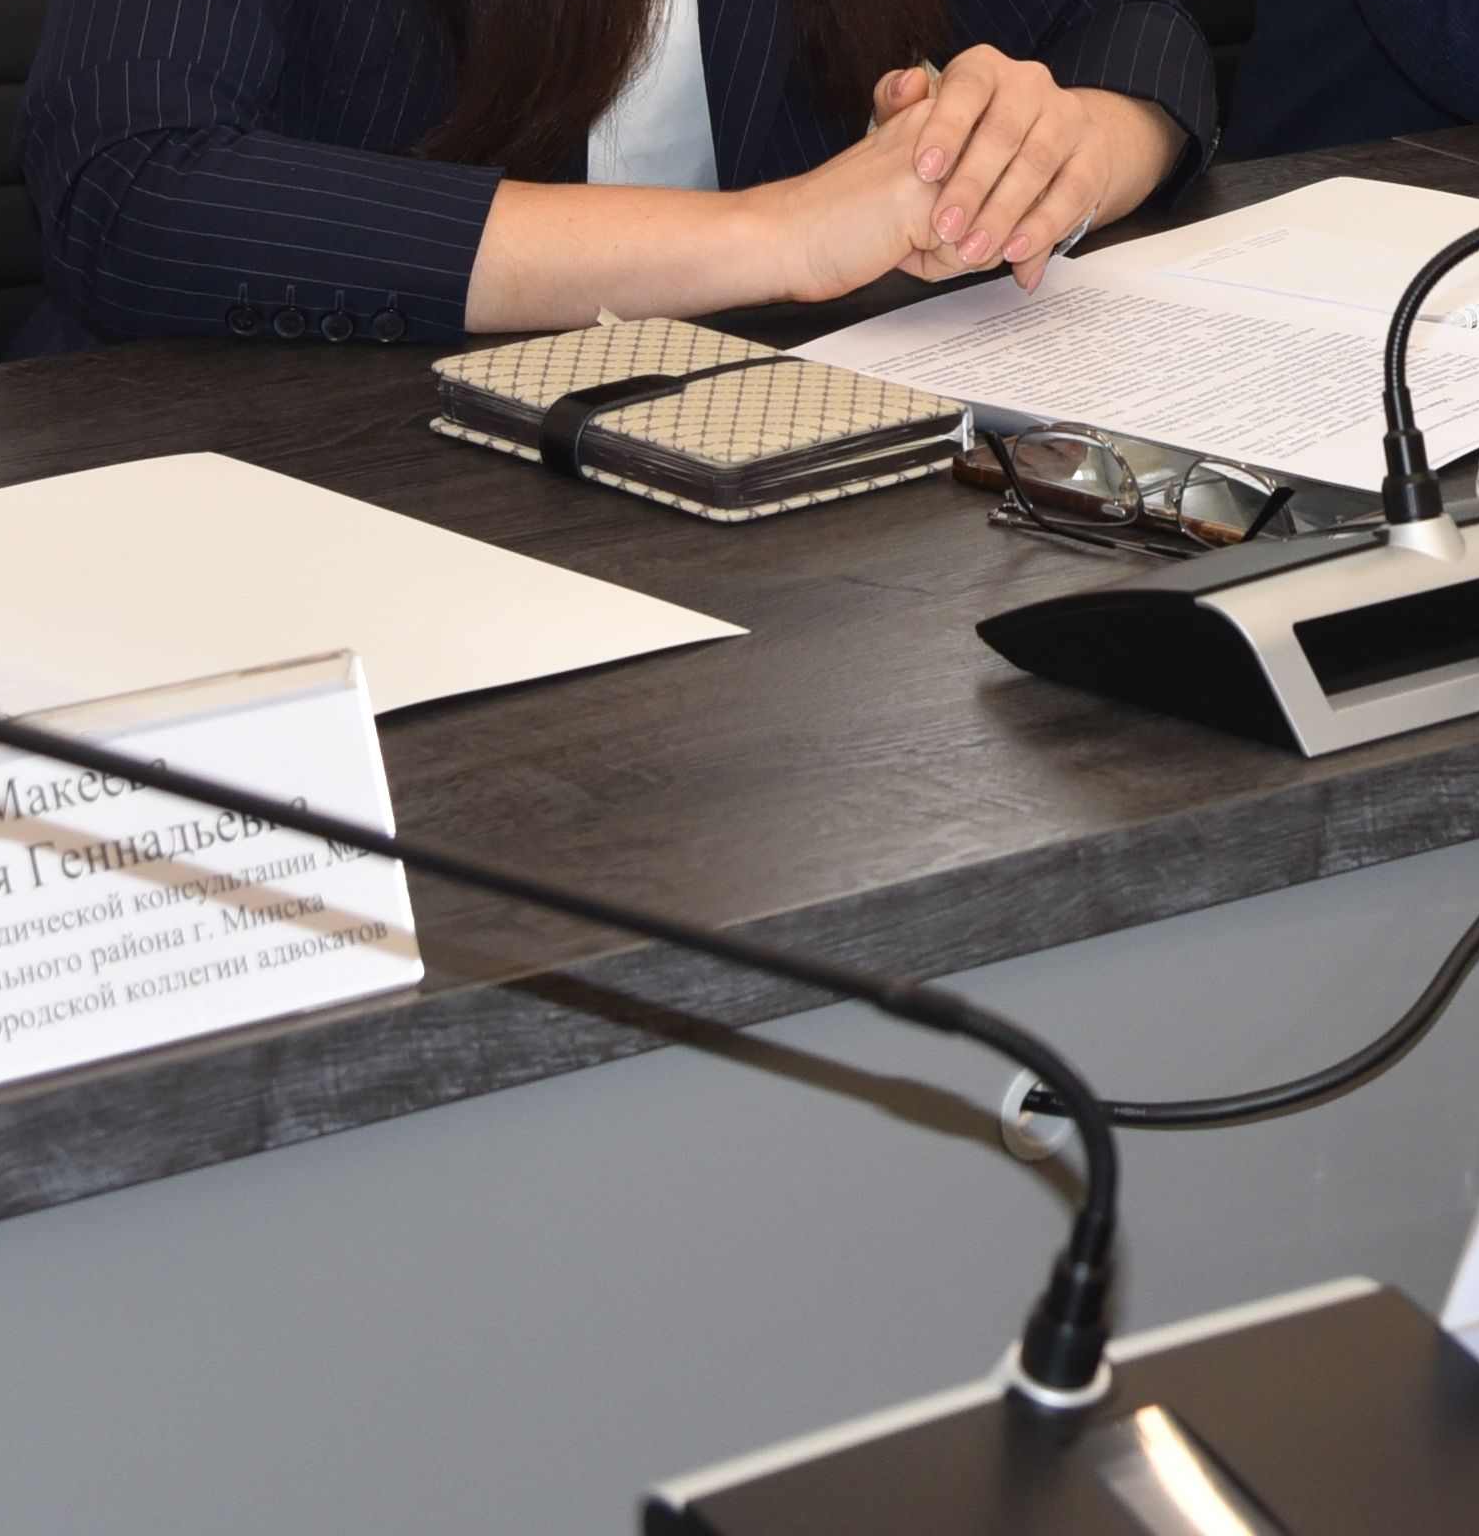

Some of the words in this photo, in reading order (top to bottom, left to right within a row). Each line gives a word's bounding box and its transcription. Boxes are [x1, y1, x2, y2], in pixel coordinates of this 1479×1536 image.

[26, 796, 309, 888] Геннадьев
[134, 851, 317, 913] консультации
[91, 925, 186, 975] района
[192, 922, 215, 944] г.
[221, 892, 325, 935] Минска
[126, 956, 250, 1004] коллегии
[257, 919, 389, 972] адвокатов
